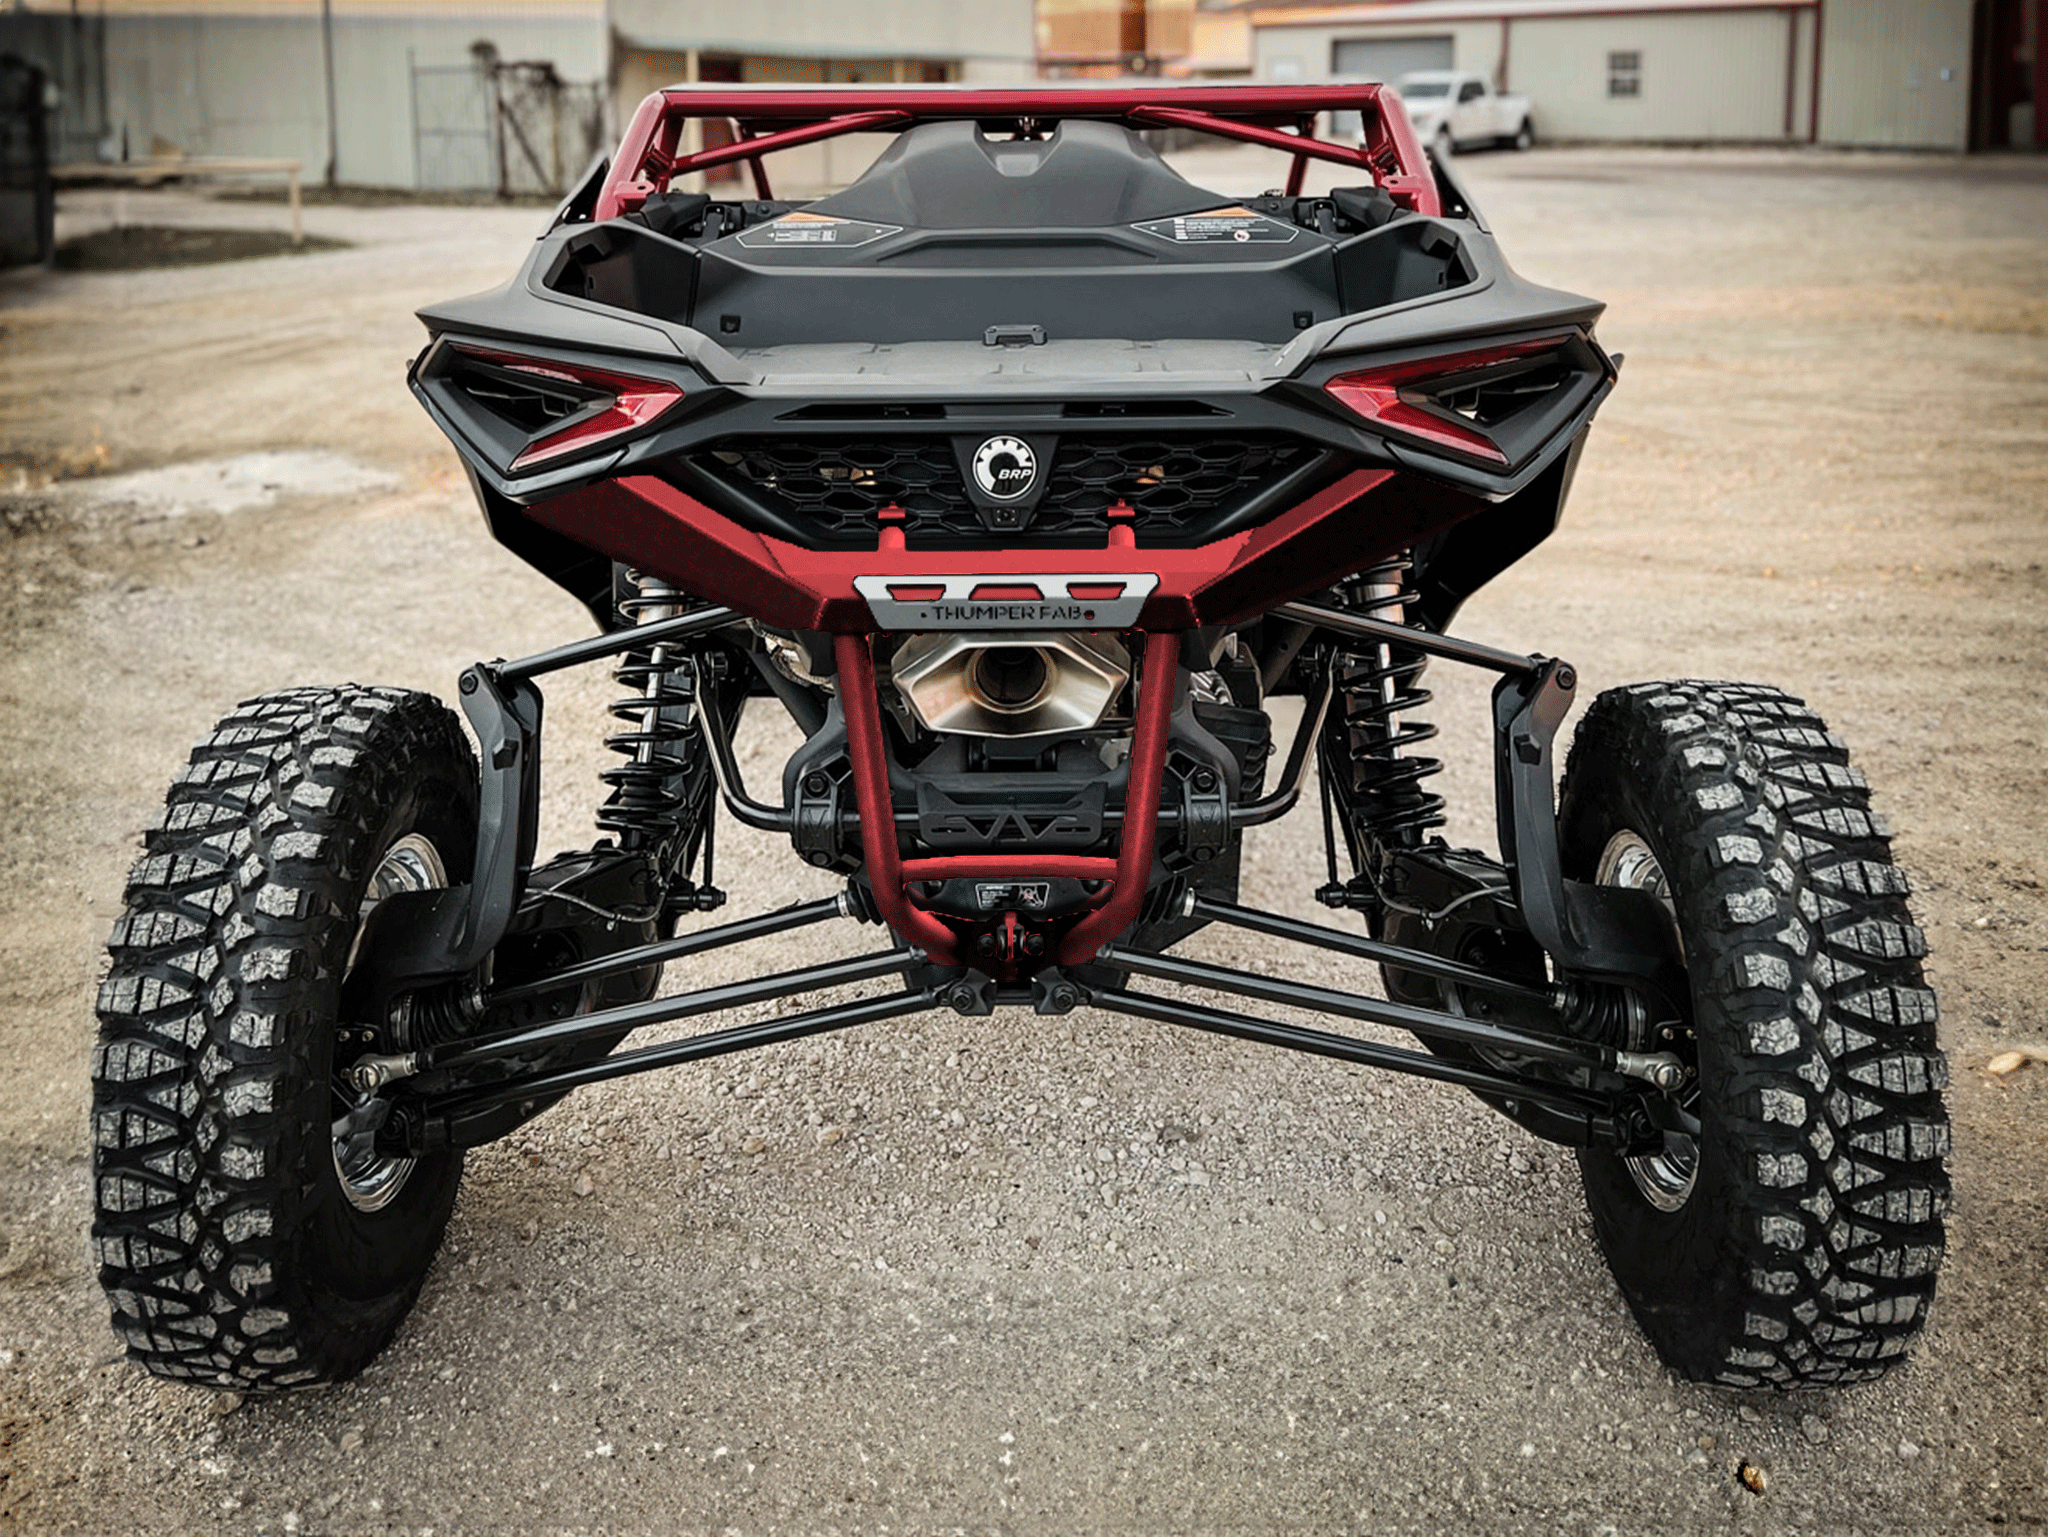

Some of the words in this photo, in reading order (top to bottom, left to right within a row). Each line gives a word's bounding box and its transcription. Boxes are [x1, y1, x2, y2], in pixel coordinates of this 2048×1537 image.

[998, 468, 1032, 480] BRP
[931, 606, 1035, 621] THUMPER
[1039, 606, 1082, 620] FAB
